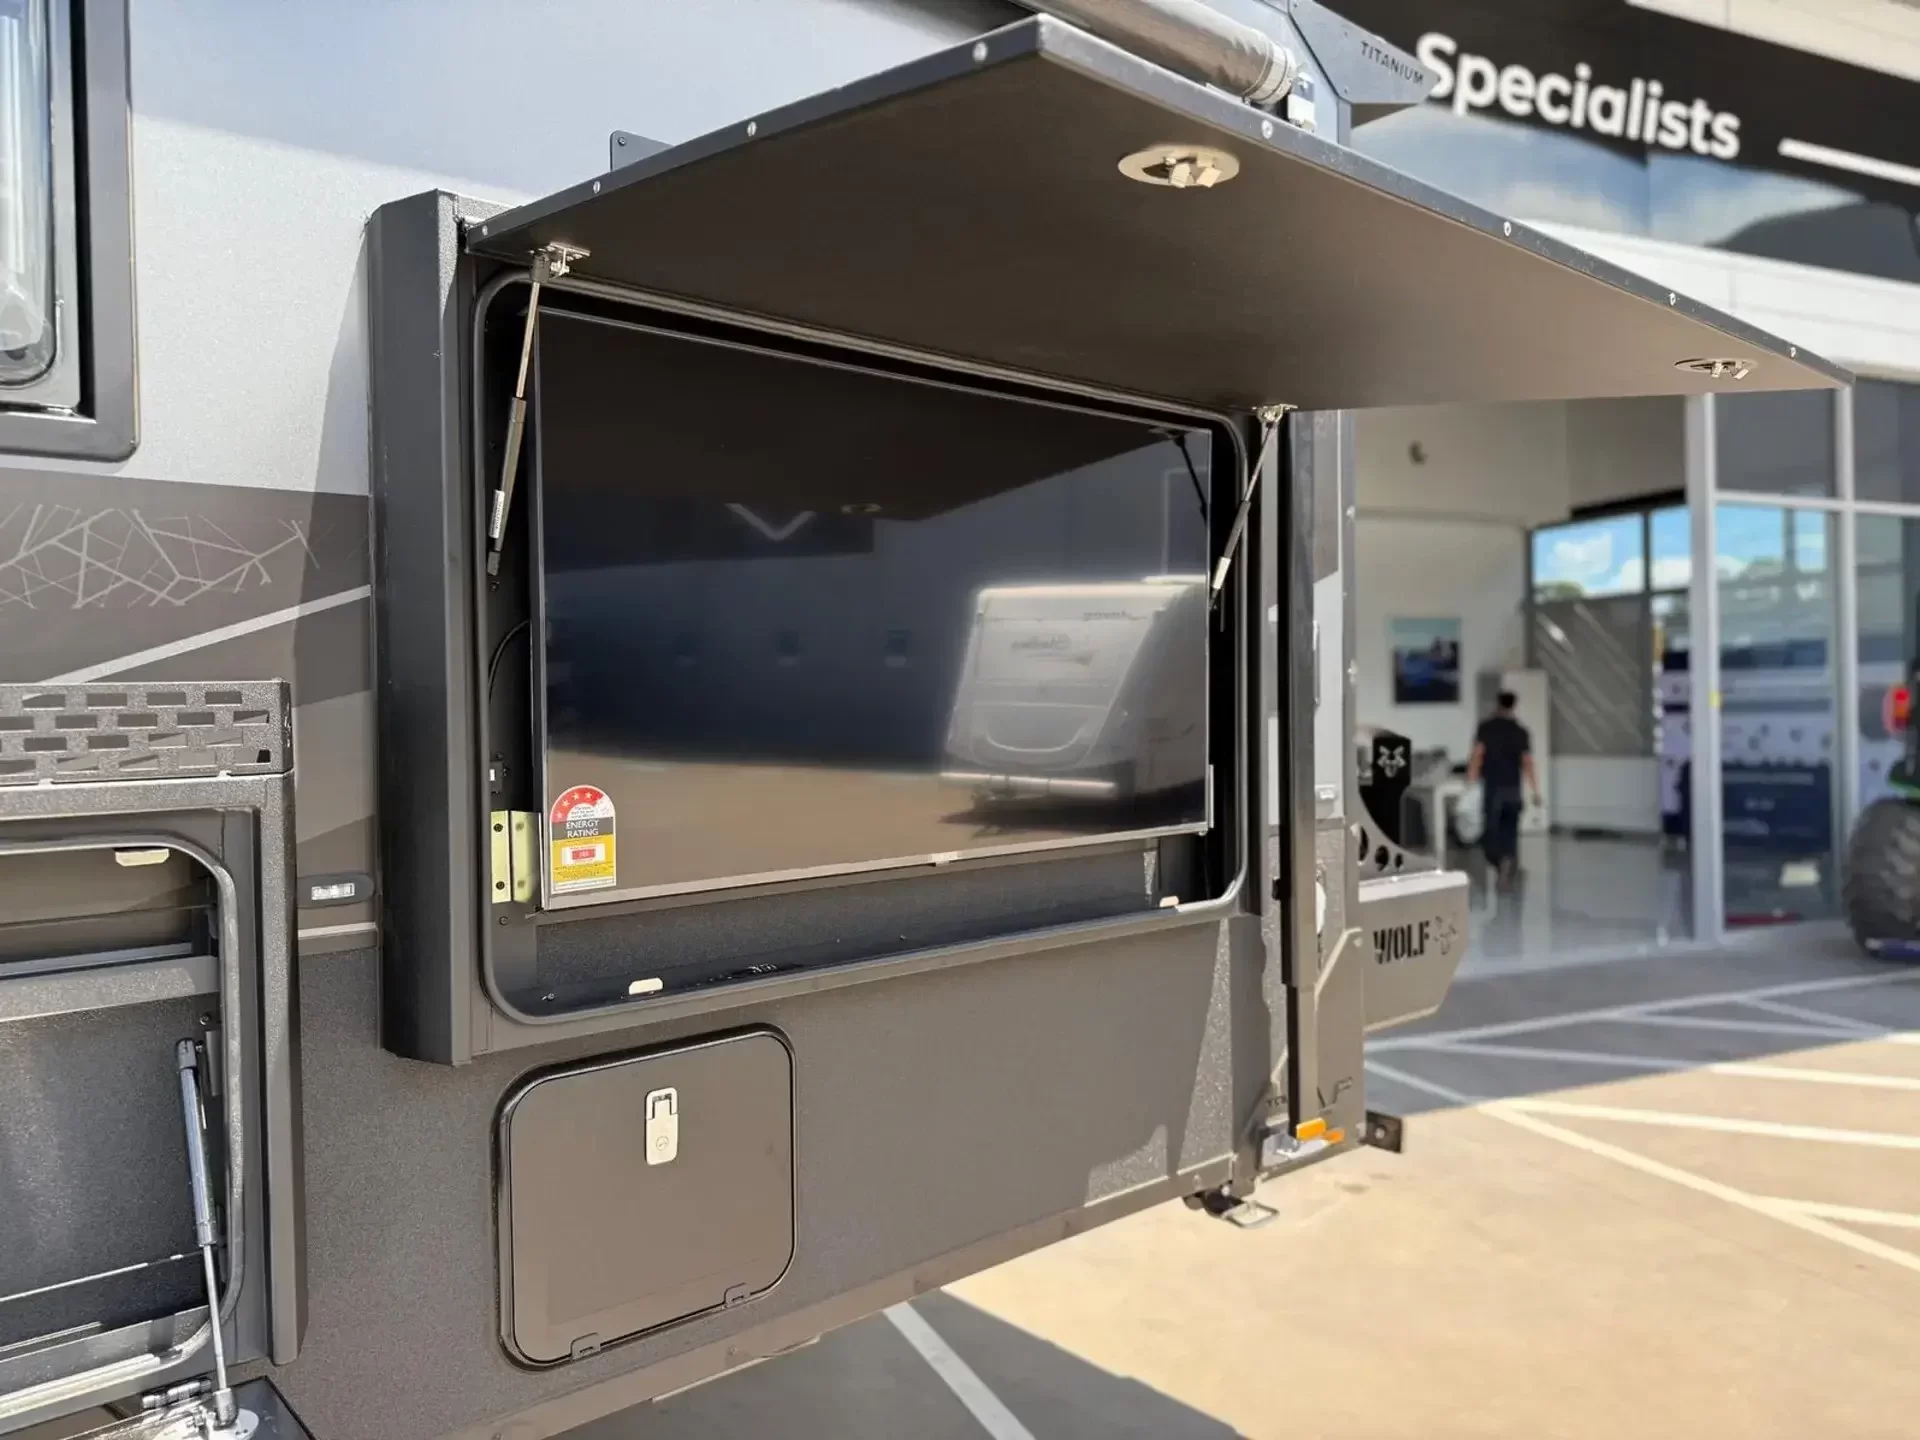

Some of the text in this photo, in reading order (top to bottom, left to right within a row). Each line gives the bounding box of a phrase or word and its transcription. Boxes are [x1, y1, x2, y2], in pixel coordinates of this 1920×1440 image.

[1361, 40, 1423, 84] TITANIUM
[1417, 33, 1741, 158] Specialists
[566, 819, 599, 830] ENERGY
[567, 828, 599, 838] RATING
[1373, 920, 1430, 965] WOLF
